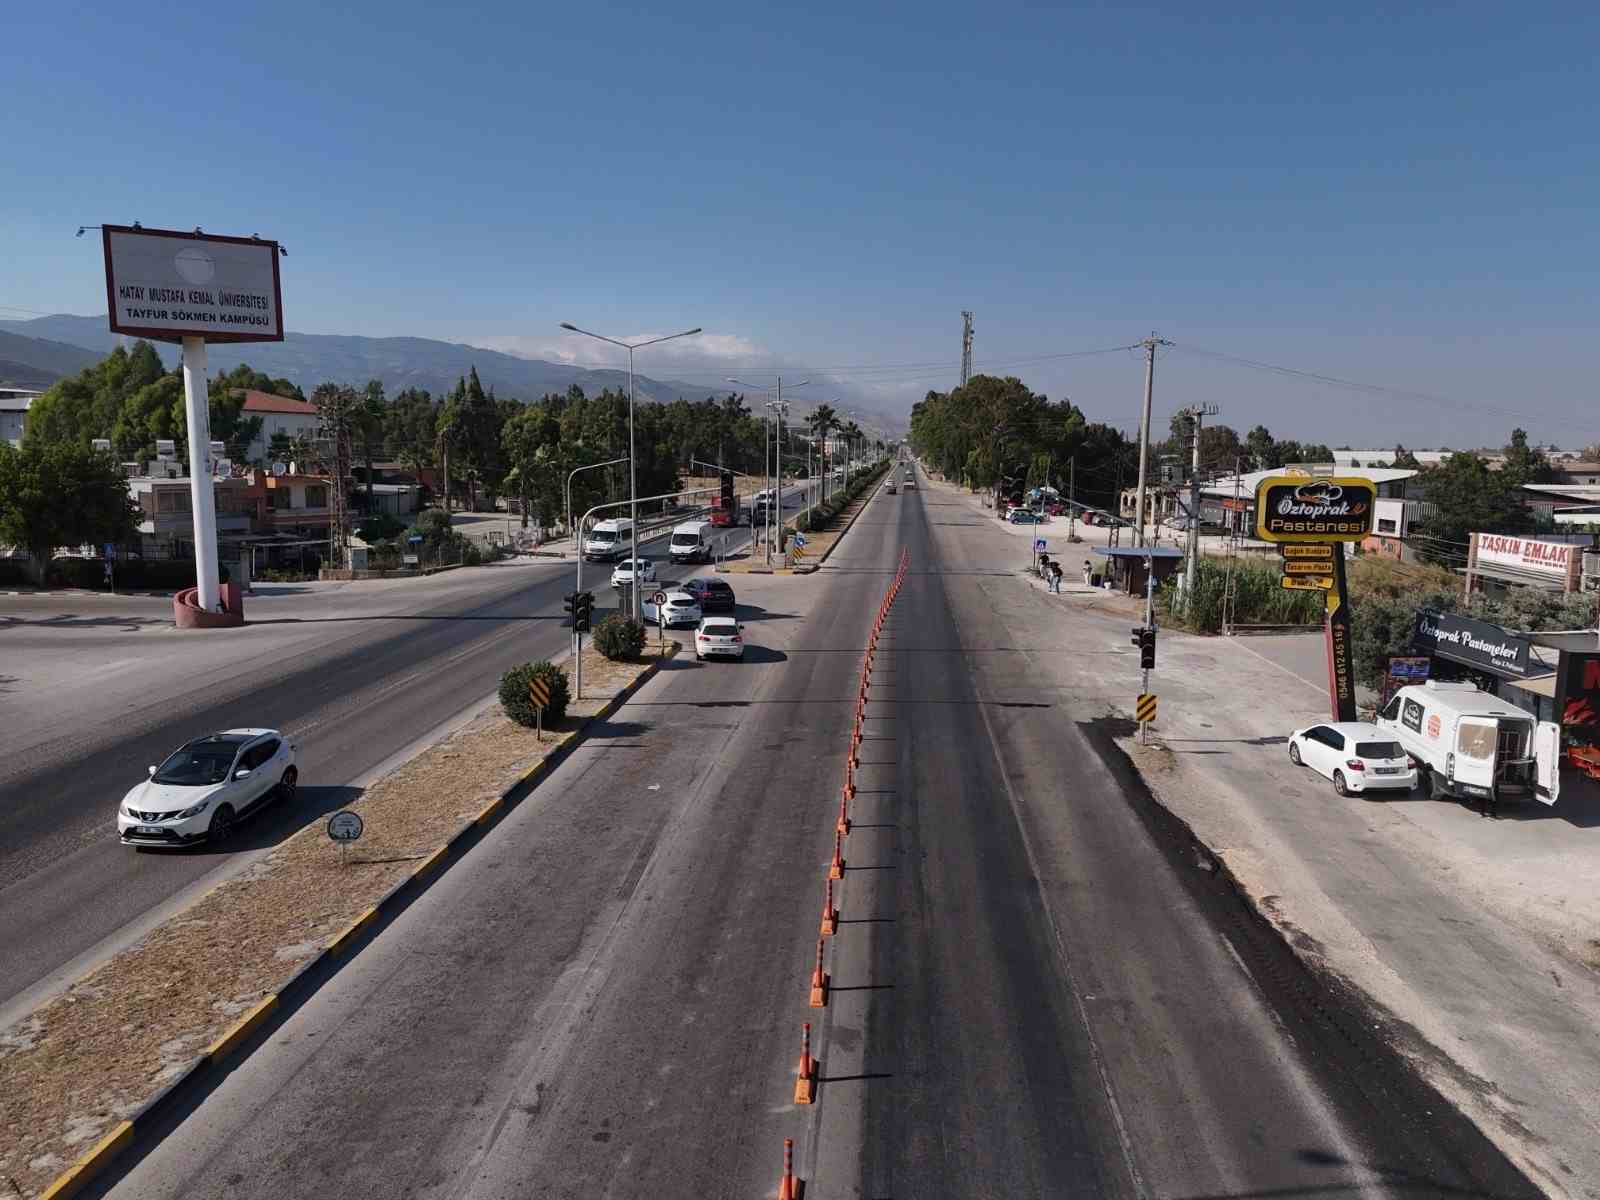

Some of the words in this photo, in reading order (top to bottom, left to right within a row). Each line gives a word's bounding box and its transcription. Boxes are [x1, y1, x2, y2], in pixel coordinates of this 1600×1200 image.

[119, 285, 145, 301] HATAY
[148, 288, 186, 304] MUSTAFA
[188, 290, 215, 306] KEMAL
[126, 308, 168, 321] TAYFUR
[171, 309, 217, 323] SÖKMEN
[219, 312, 270, 326] KAMPÜSÜ
[1277, 495, 1351, 519] Öztoprak
[1270, 519, 1365, 533] Pastanesi
[1481, 535, 1522, 555] TAŞKIN
[1523, 542, 1569, 563] EMLAK
[1419, 617, 1460, 644] Öztoprak
[1461, 631, 1520, 660] Pastaneleri
